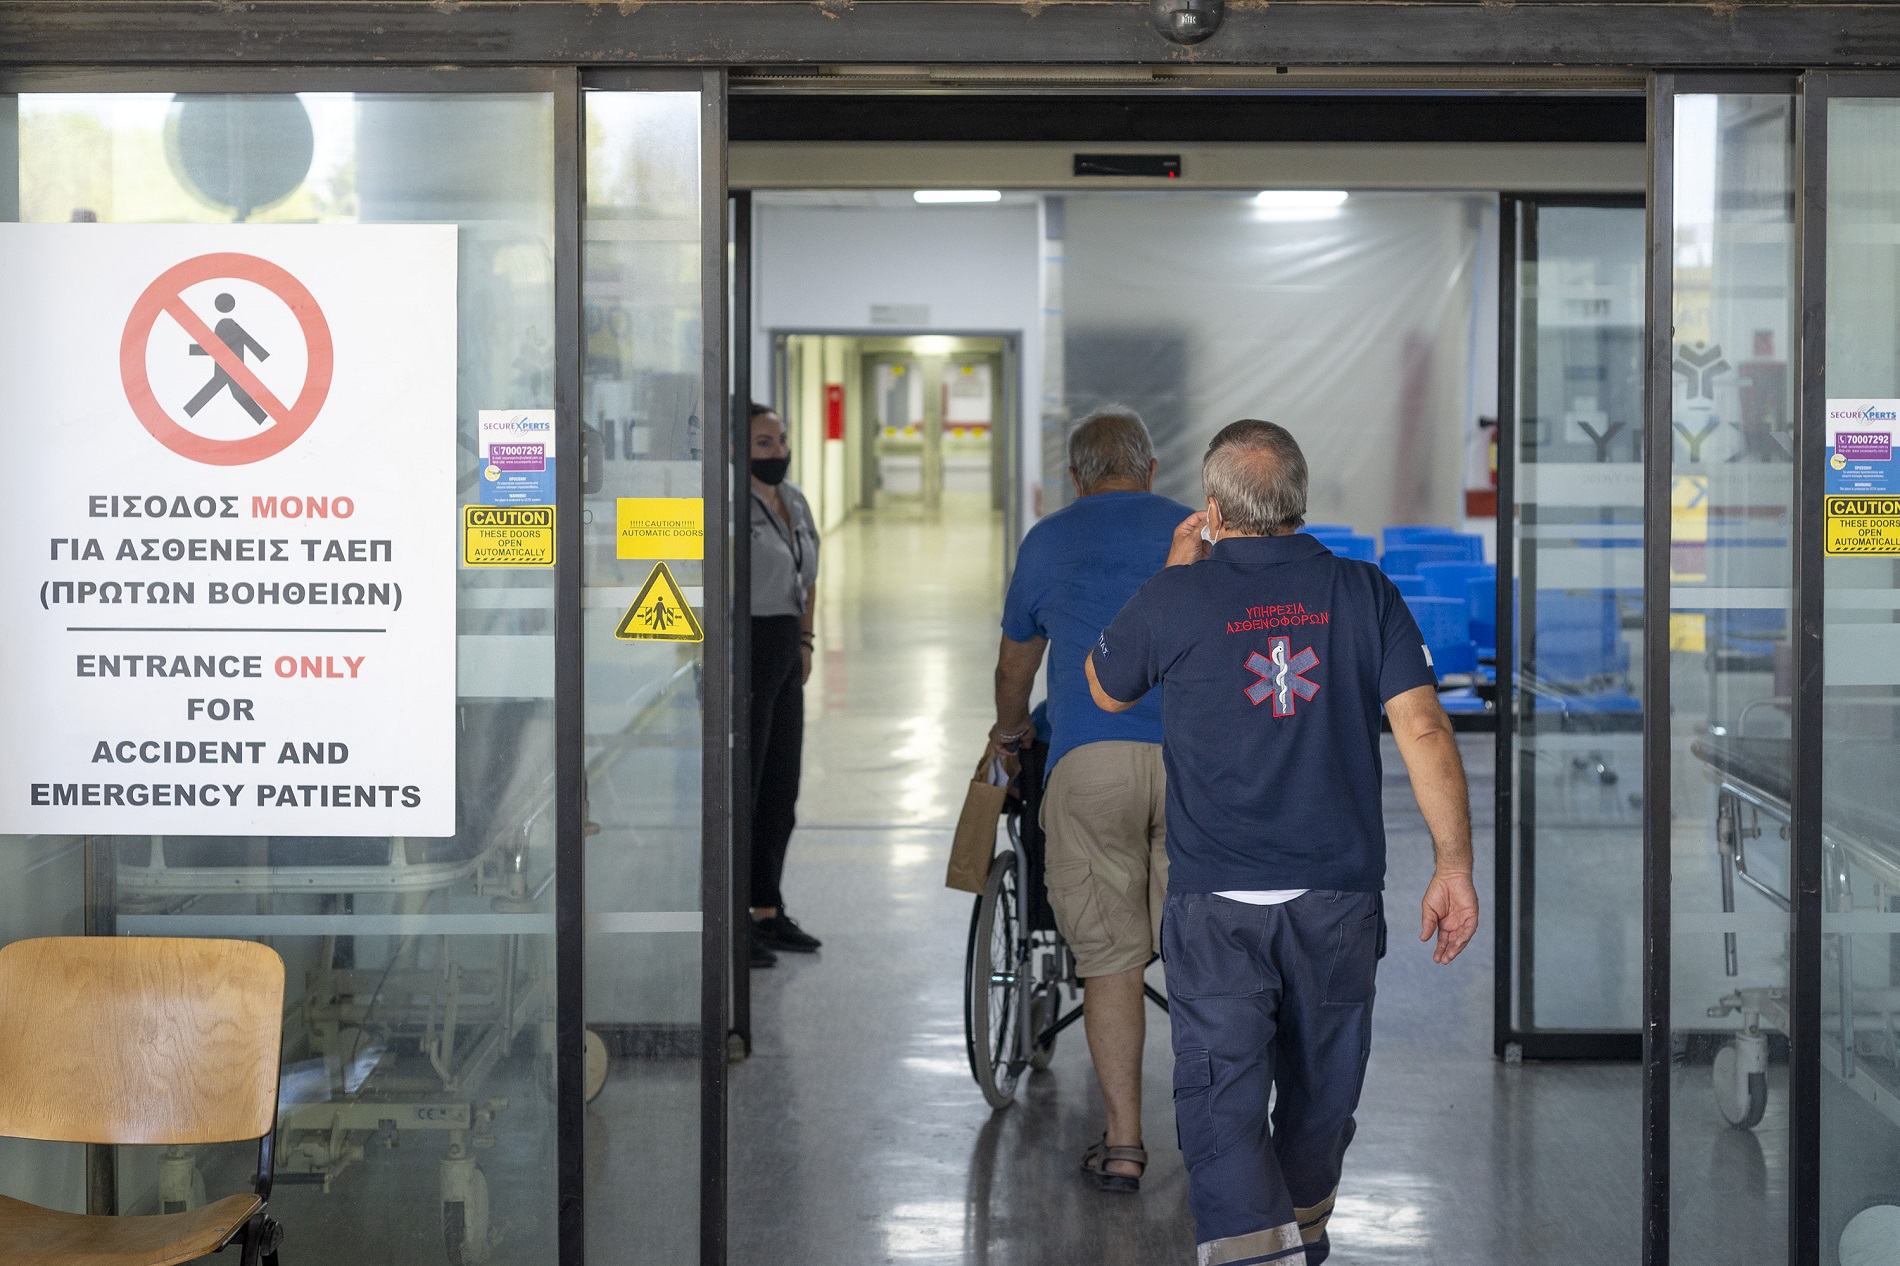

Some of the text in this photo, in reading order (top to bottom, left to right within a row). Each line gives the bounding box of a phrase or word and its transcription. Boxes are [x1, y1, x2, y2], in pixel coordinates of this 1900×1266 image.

[1831, 407, 1897, 422] SECUREXPERTS
[484, 418, 550, 433] SECUREXPERTS
[1847, 435, 1889, 444] 70007292
[501, 446, 543, 455] 70007292
[88, 495, 355, 519] ΕΙΣΟΔΟΣ ΜΟΝΟ
[473, 511, 545, 525] CAUTION
[1840, 519, 1900, 528] THESE DOORS
[480, 529, 541, 538] THESE DOORS
[621, 529, 704, 537] AUTOMATIC DOORS
[1858, 528, 1882, 536] OPEN
[497, 539, 522, 547] OPEN
[1835, 537, 1900, 545] AUTOMATICALL
[50, 538, 392, 562] ΓΙΑ ΑΣΘΕΝΕΙΣ ΤΑΕΠ
[474, 548, 546, 556] AUTOMATICALLY
[39, 581, 402, 612] (ΠΡΩΤΩΝ ΒΟΗΘΕΙΩΝ)
[1245, 602, 1306, 619] ΥΠΗΡΕΣΙΑ
[1226, 612, 1329, 634] ΑΣΘΕΝΟΦΟΡΩΝ
[76, 654, 366, 679] ENTRANCE ONLY
[187, 698, 255, 721] FOR
[91, 741, 350, 765] ACCIDENT AND
[30, 783, 422, 808] EMERGENCY PATIENTS
